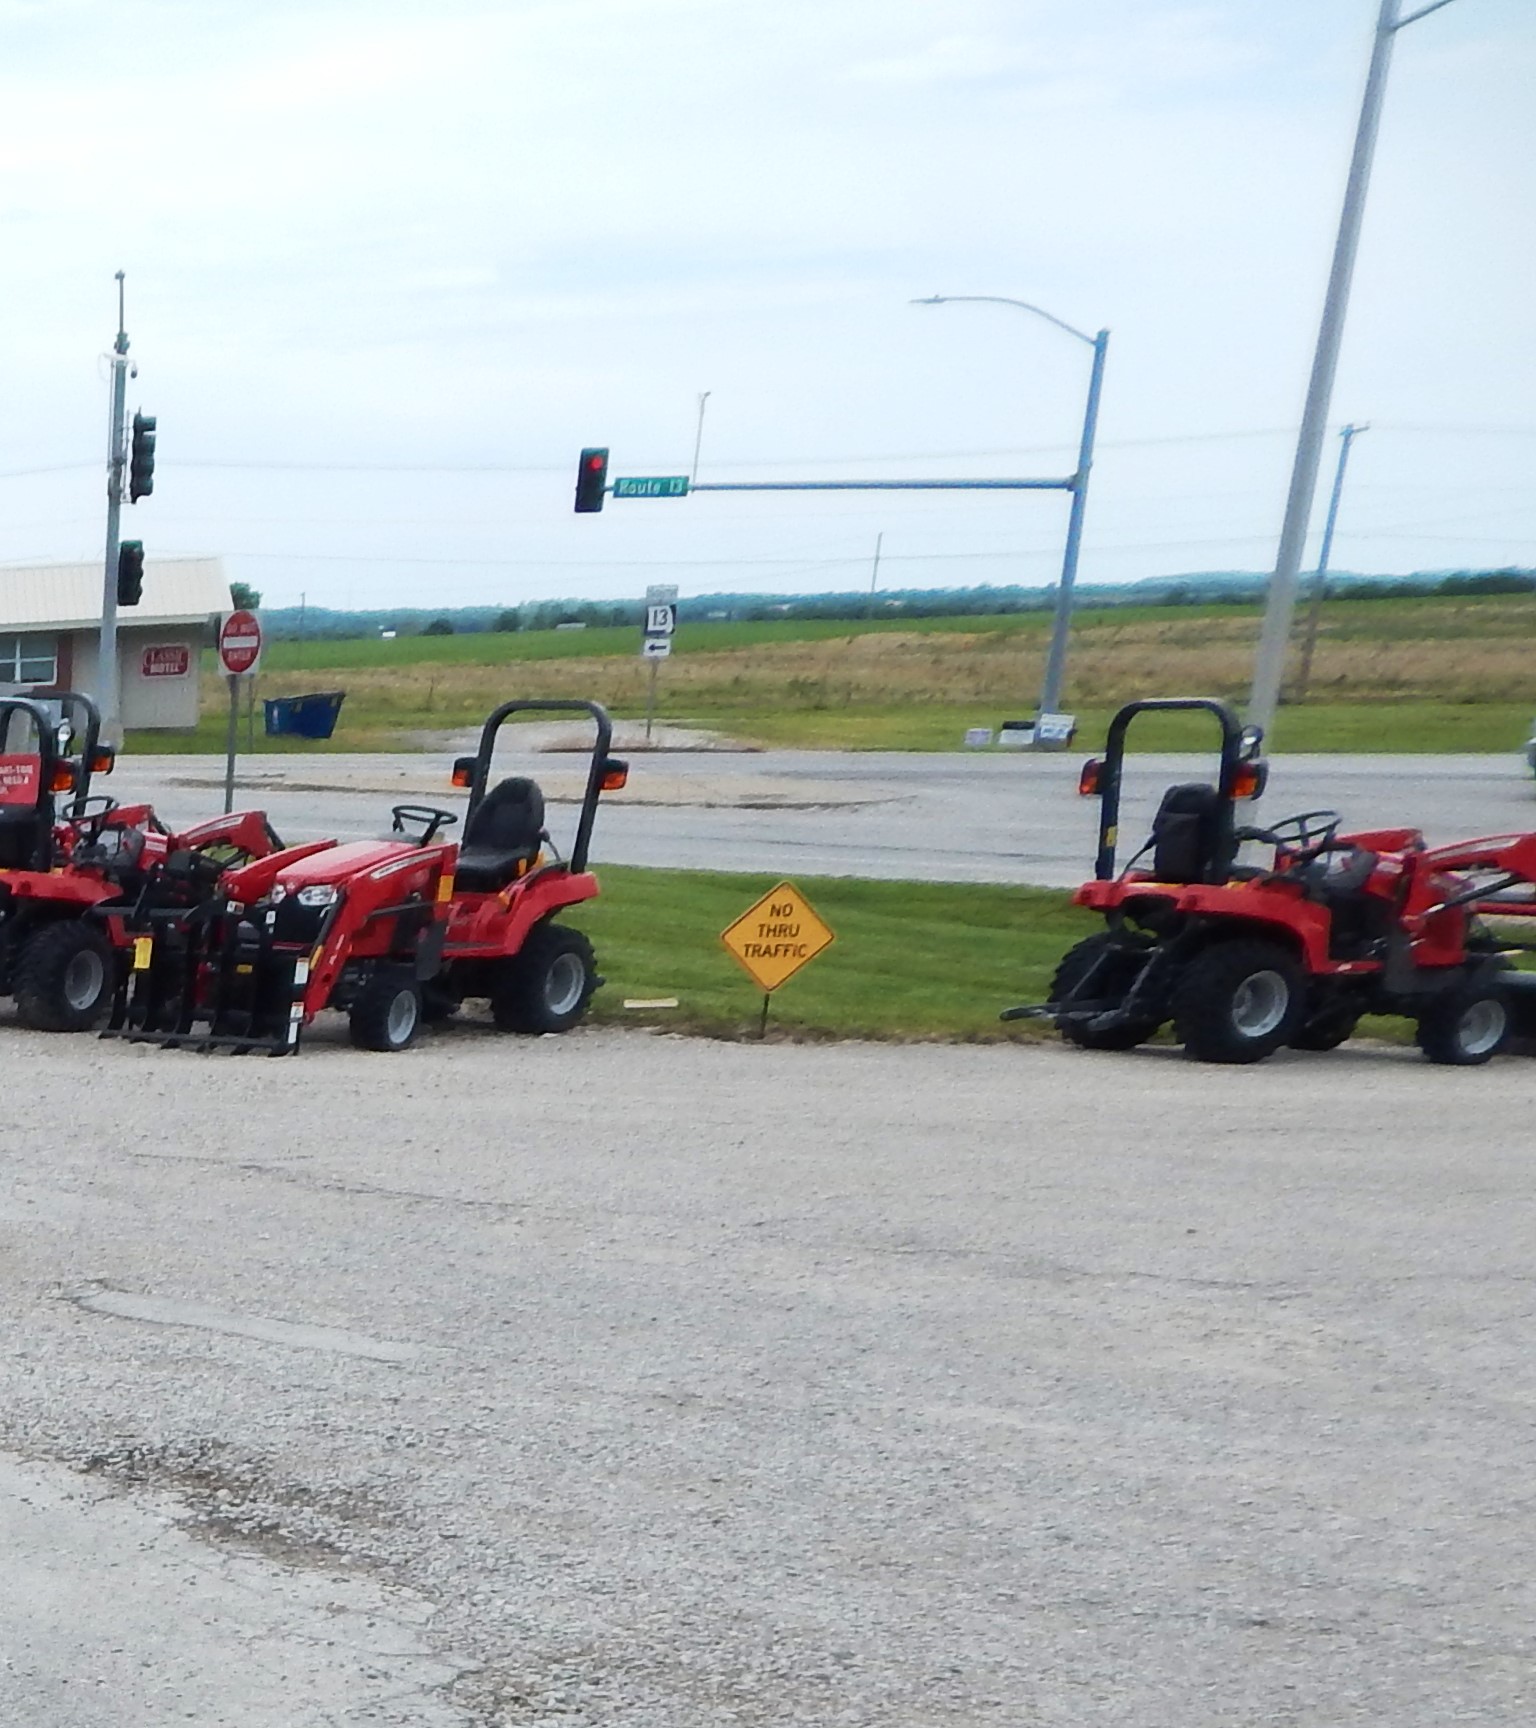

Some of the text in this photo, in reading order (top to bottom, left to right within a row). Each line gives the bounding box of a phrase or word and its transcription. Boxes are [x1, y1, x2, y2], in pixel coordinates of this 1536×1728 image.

[619, 479, 683, 495] Route 13
[652, 608, 668, 626] 13
[769, 903, 794, 918] NO
[758, 923, 800, 938] THRU
[744, 943, 807, 958] TRAFFIC
